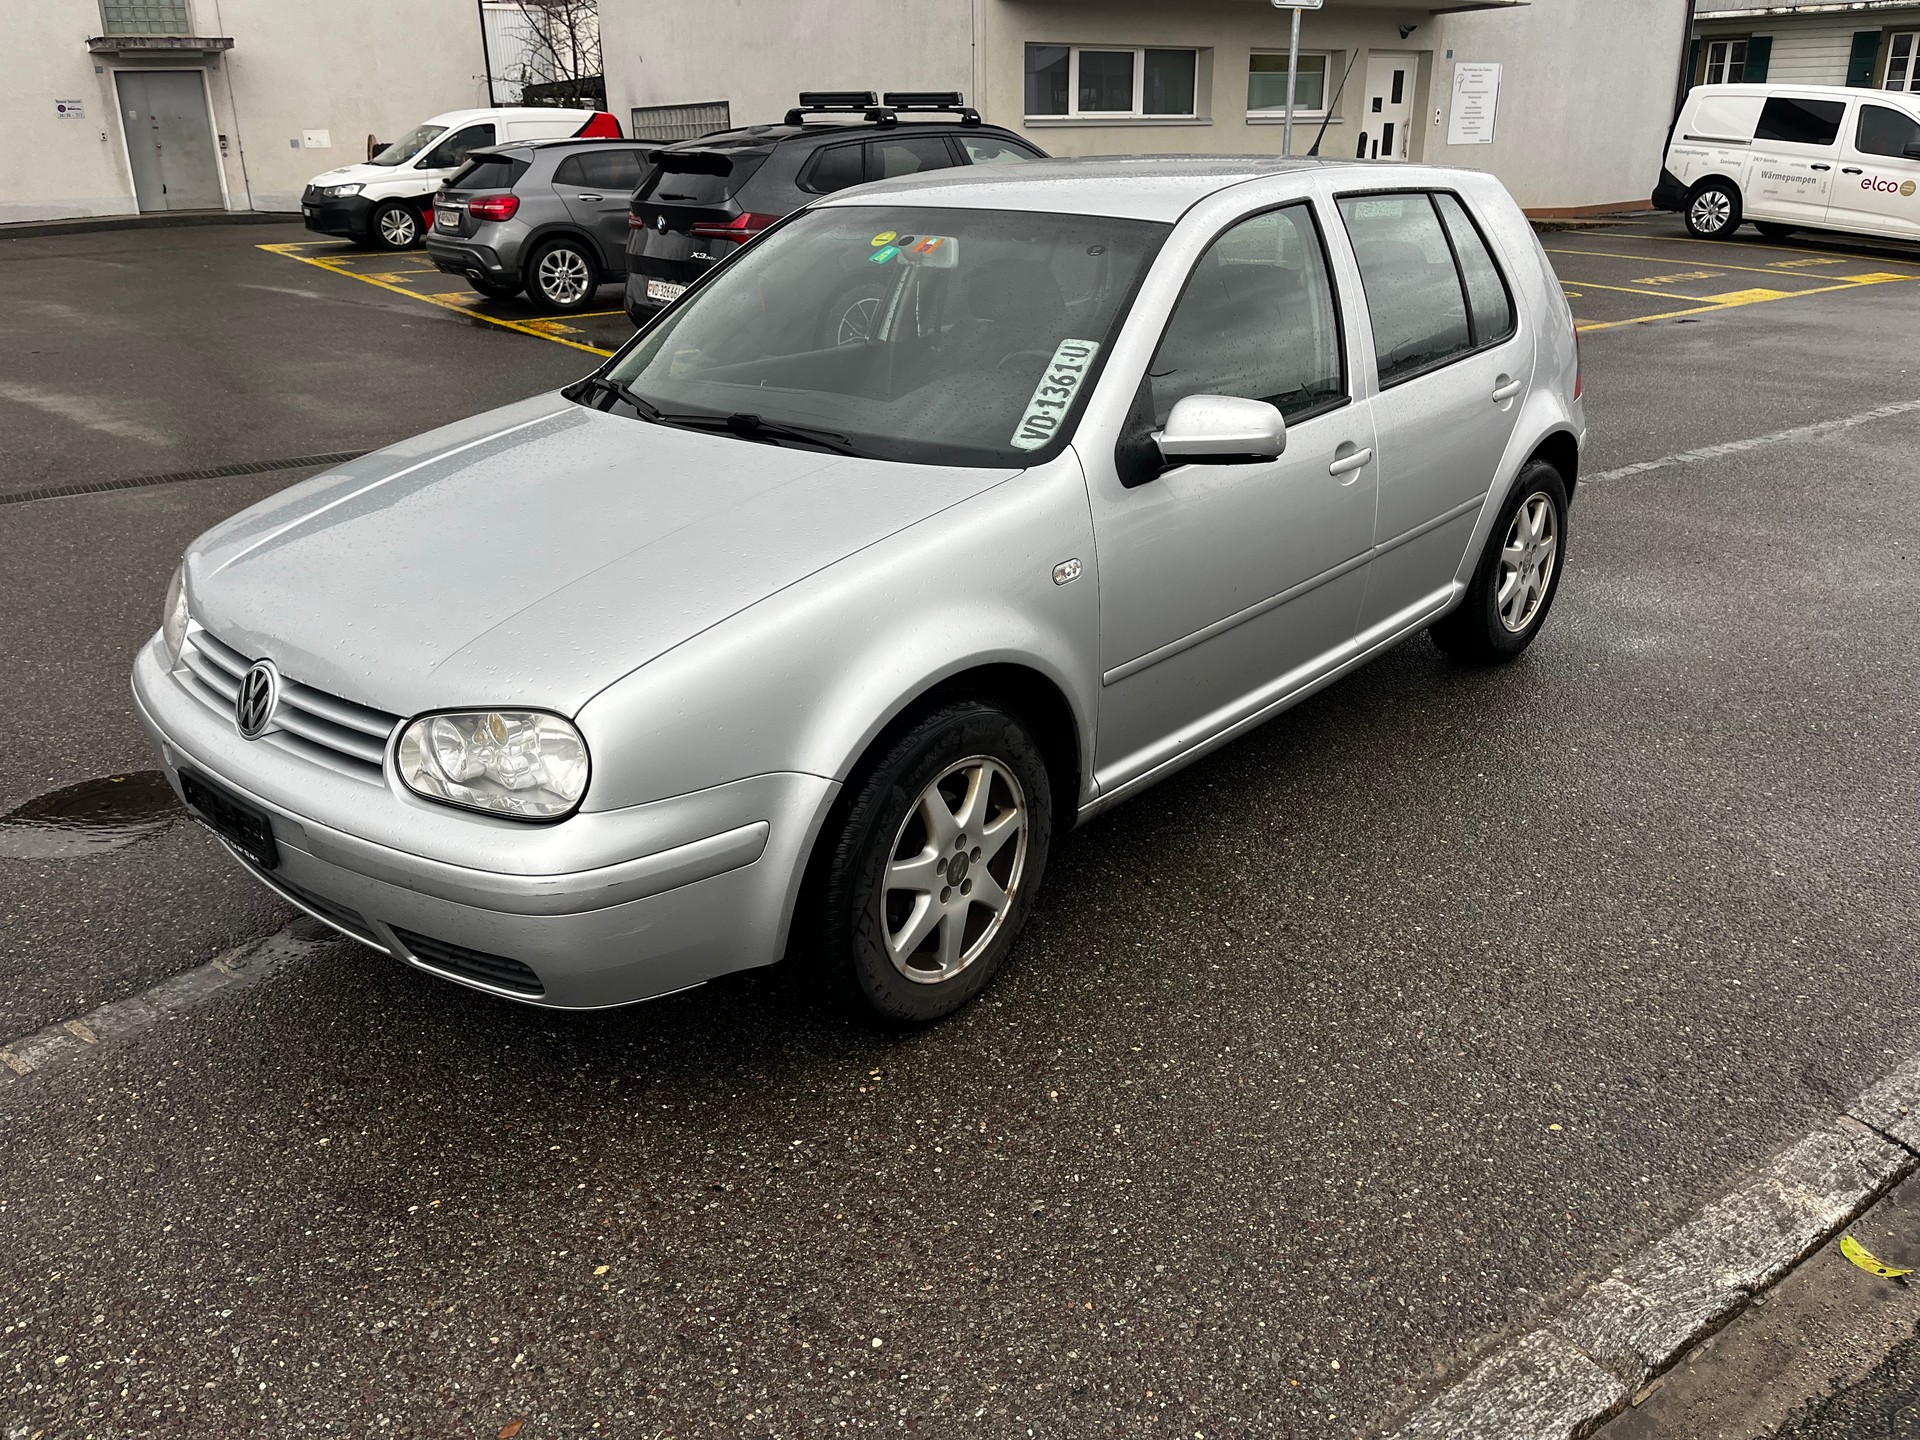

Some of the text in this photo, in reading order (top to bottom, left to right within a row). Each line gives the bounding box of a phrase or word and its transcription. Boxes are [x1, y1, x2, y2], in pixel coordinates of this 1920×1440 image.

[1761, 170, 1817, 185] Wärmepumpen
[1860, 175, 1898, 193] elco
[690, 251, 707, 259] X3
